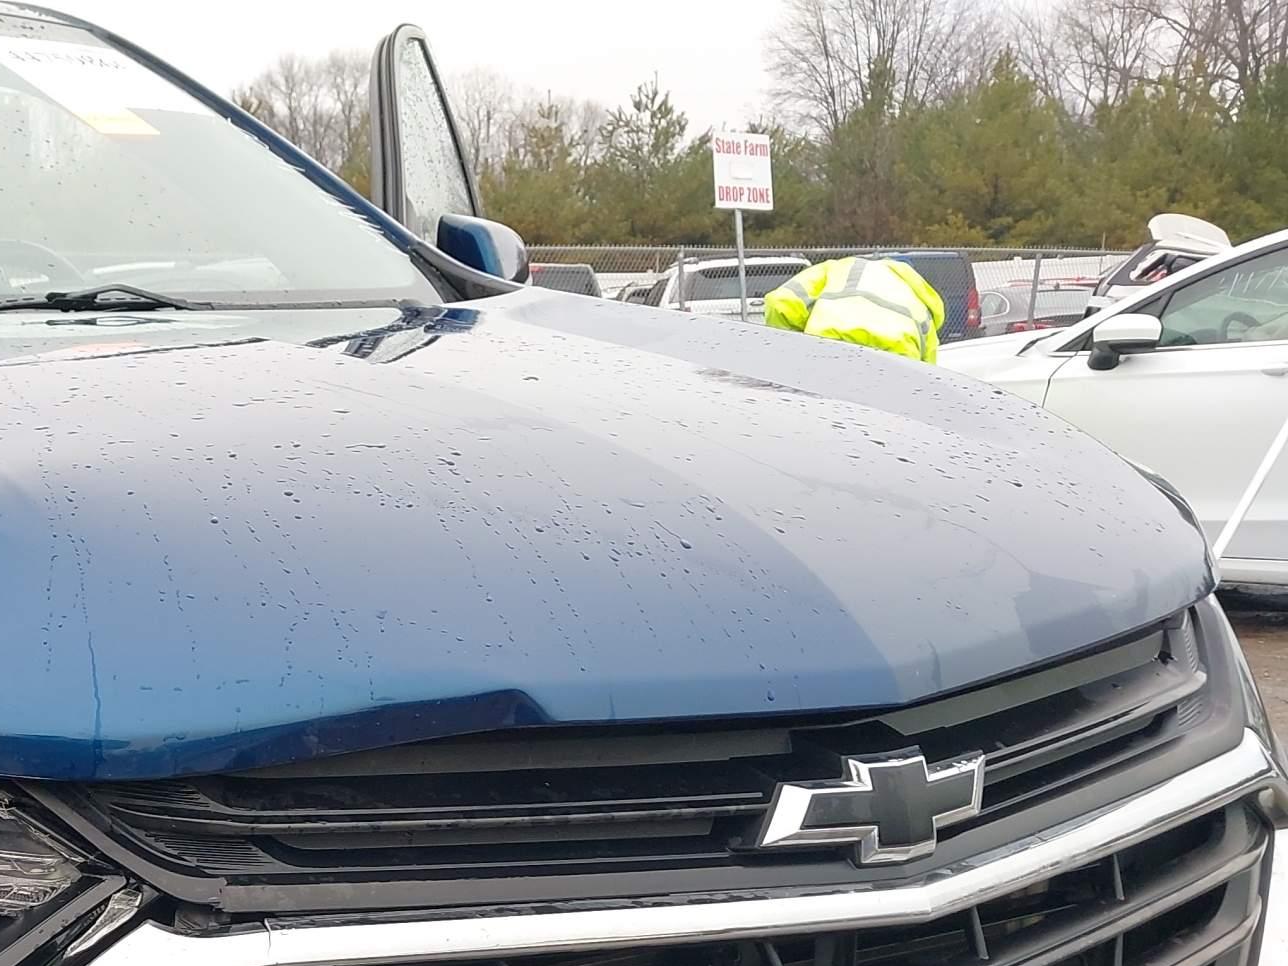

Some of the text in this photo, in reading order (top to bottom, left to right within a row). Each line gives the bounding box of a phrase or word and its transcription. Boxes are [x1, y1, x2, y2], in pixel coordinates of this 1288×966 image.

[715, 137, 768, 157] State Farm
[718, 185, 771, 204] DROP ZONE
